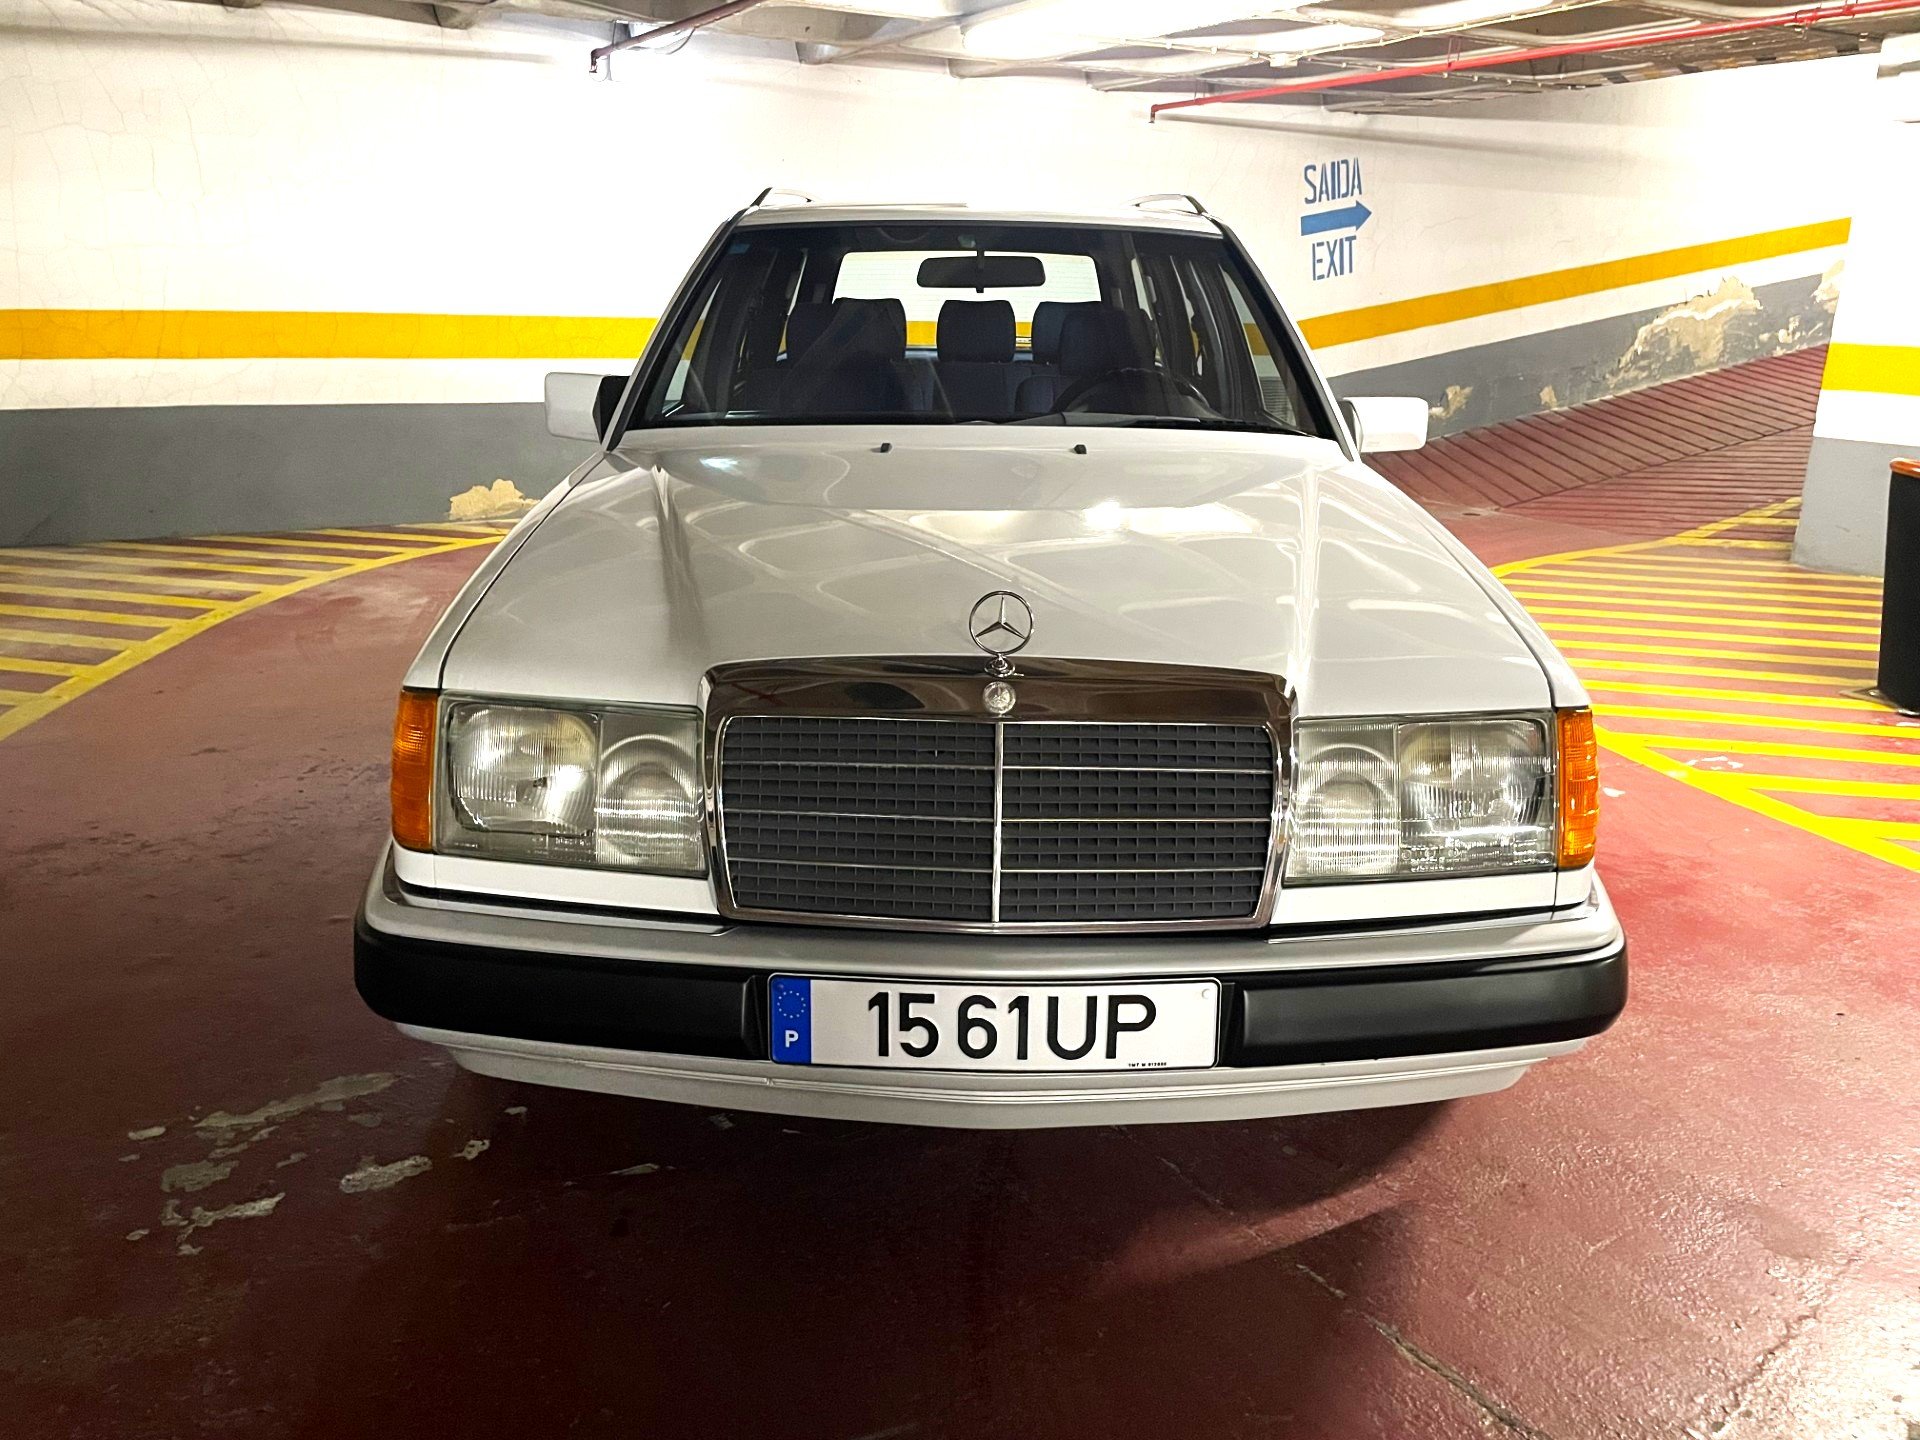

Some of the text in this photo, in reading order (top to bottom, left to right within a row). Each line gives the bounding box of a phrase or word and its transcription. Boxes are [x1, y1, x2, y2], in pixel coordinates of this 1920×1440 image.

[1304, 157, 1362, 204] SAIDA
[1312, 235, 1357, 281] EXIT
[784, 1029, 799, 1048] P
